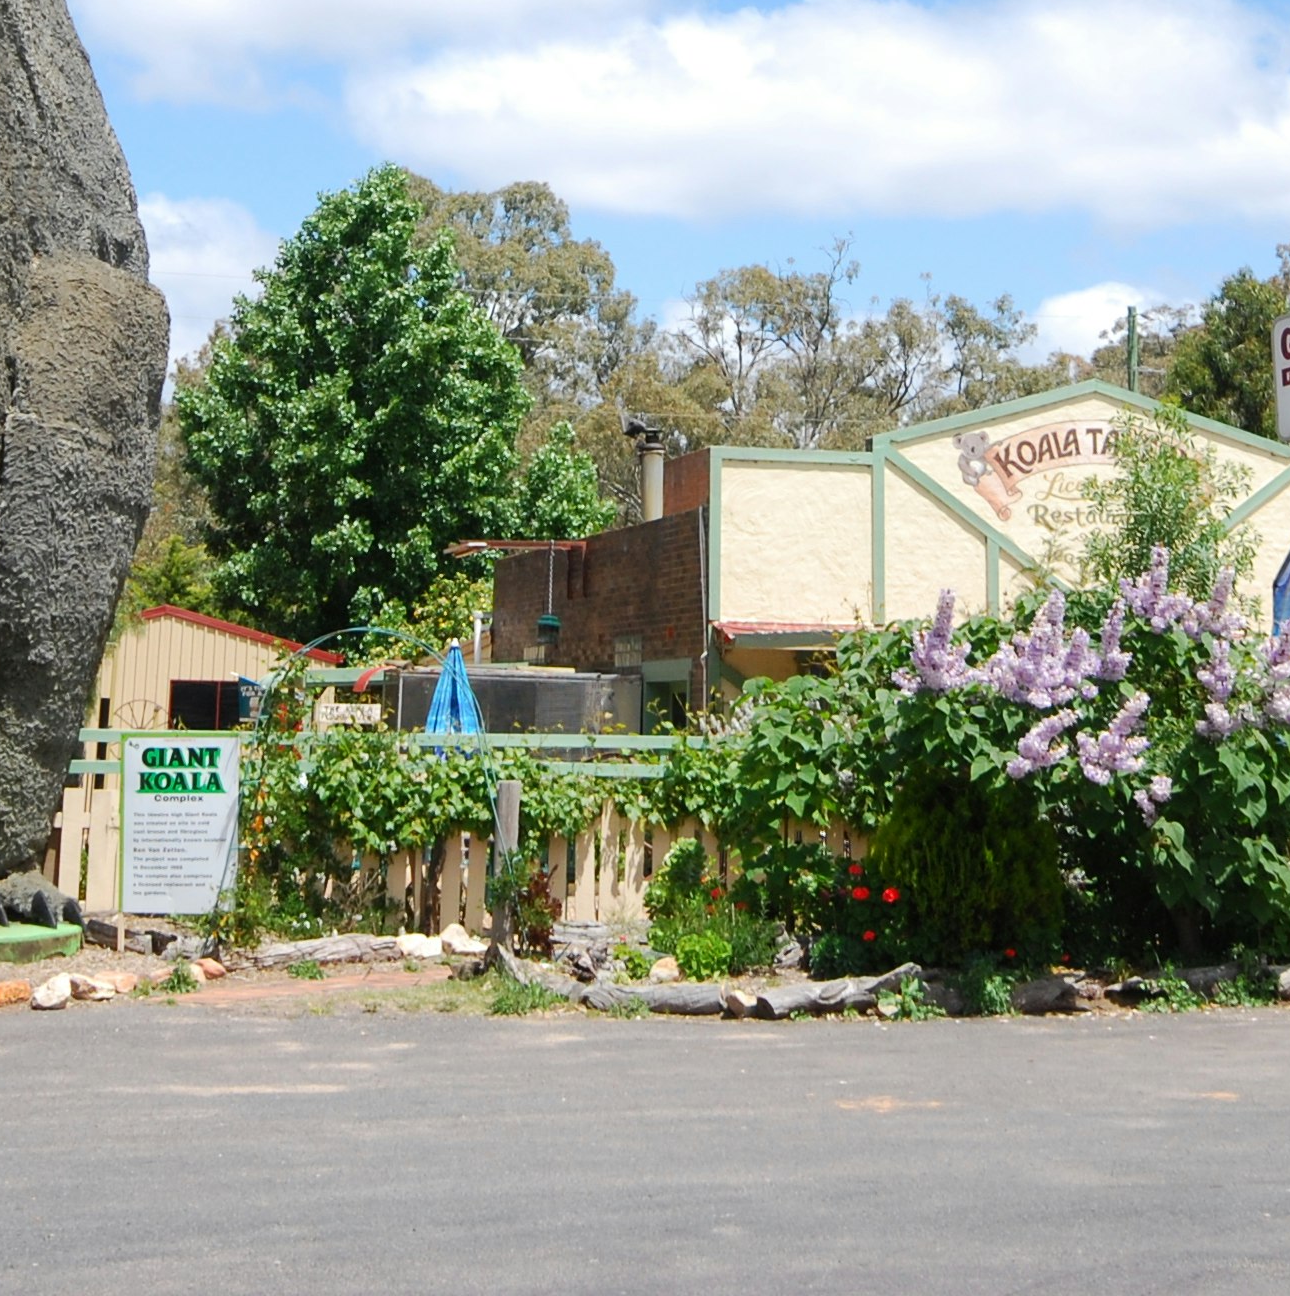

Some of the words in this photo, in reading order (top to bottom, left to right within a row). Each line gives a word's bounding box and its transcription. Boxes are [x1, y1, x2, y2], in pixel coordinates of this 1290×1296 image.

[993, 428, 1080, 478] KOALA
[141, 747, 221, 769] GIANT
[136, 771, 226, 793] KOALA
[154, 794, 204, 803] Complex
